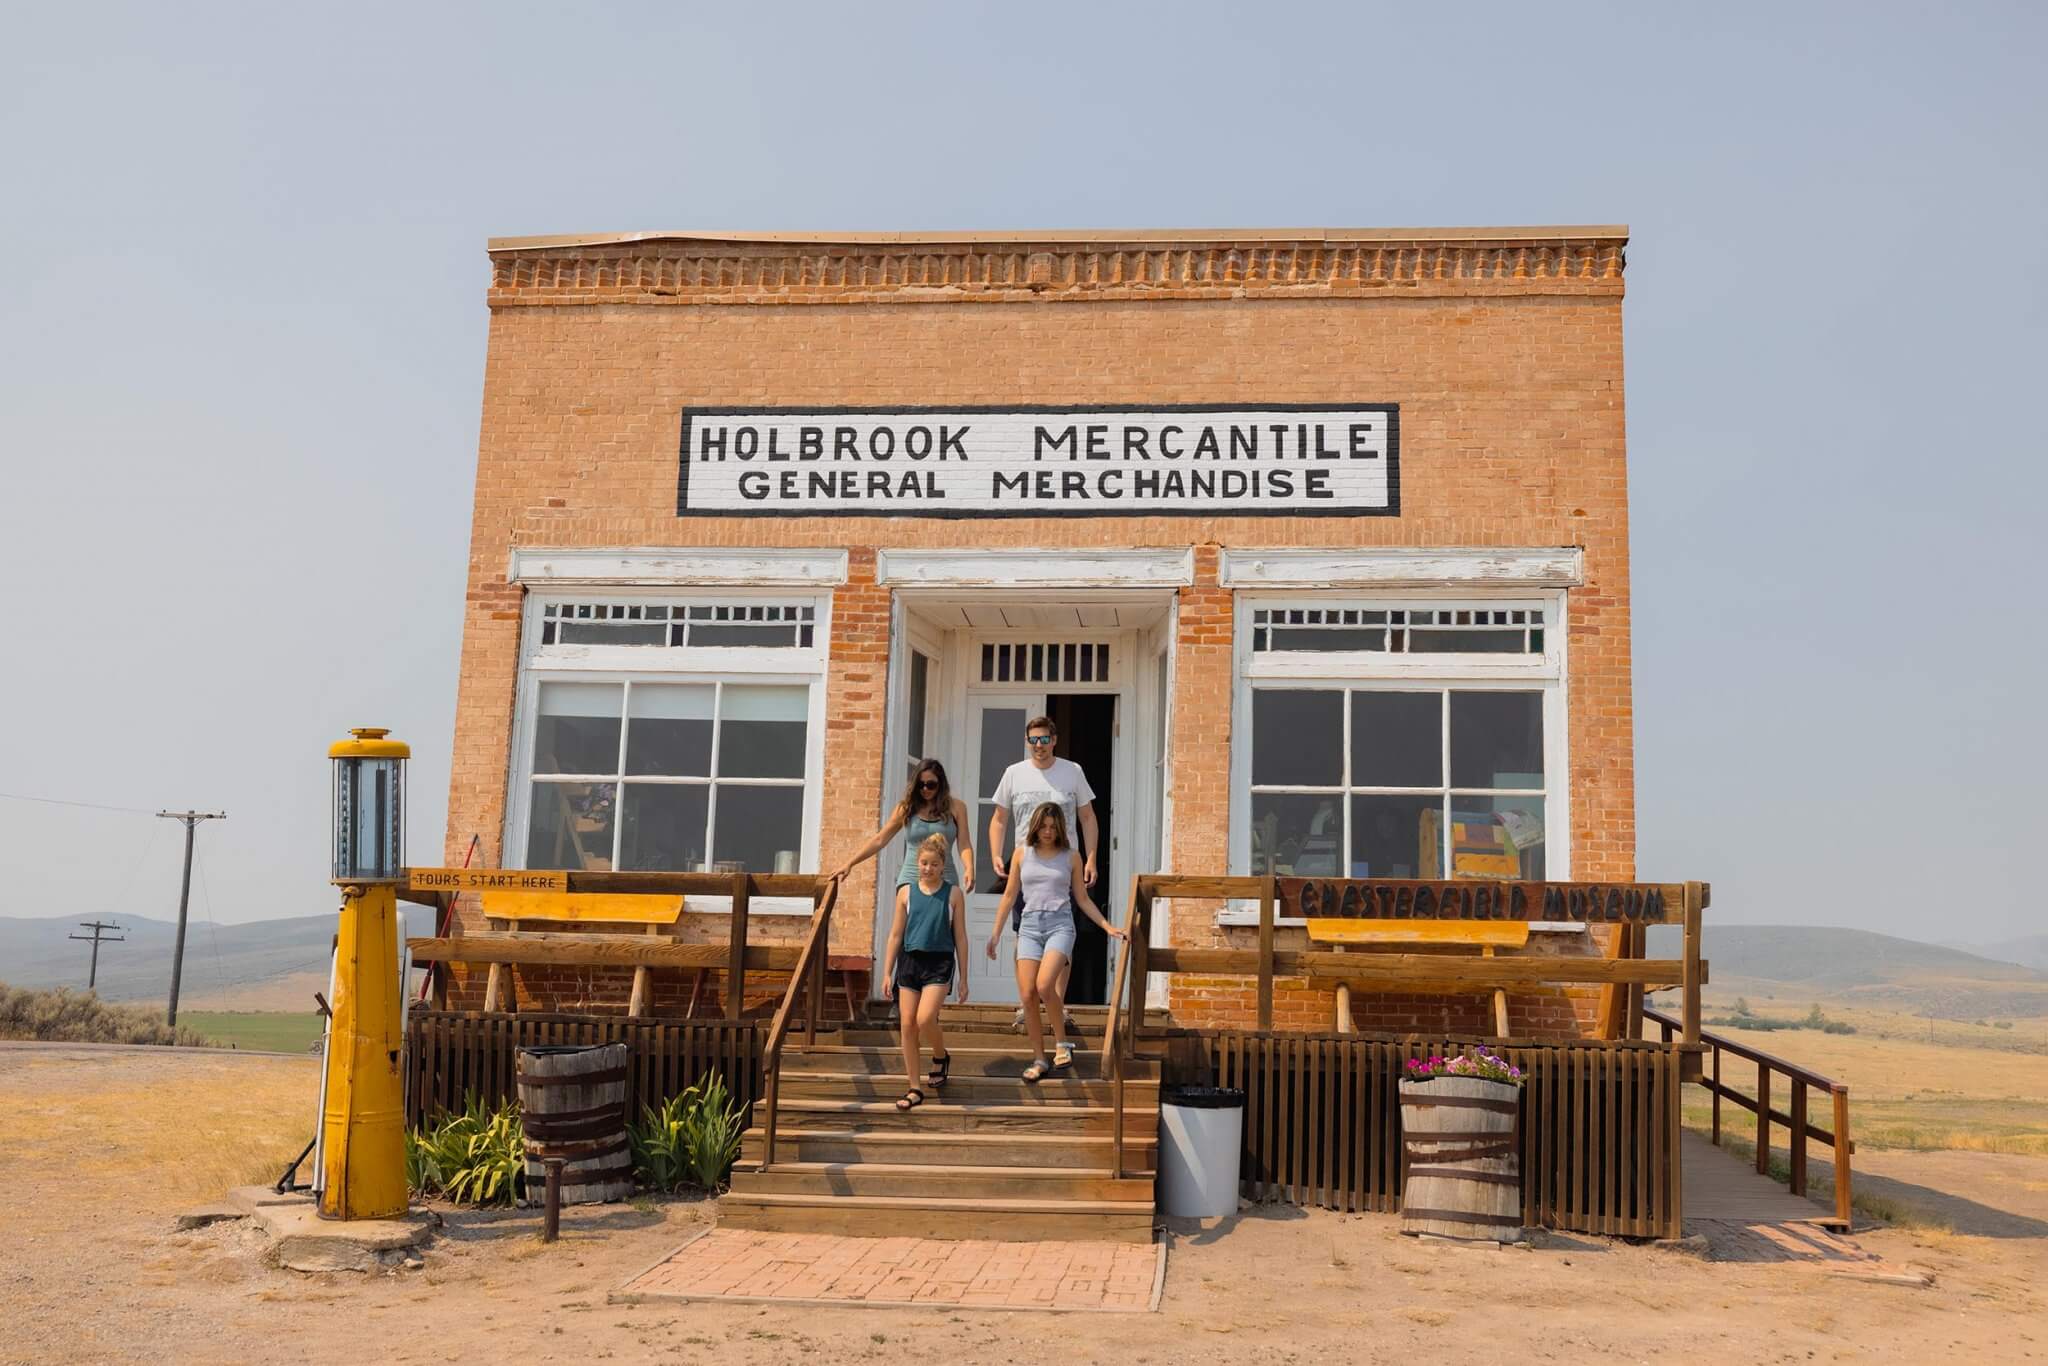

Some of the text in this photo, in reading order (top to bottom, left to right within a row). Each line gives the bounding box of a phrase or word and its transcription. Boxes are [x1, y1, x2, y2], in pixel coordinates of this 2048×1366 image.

[701, 424, 1379, 461] HOLBROOK MERCANTILE
[738, 470, 1334, 499] GENERAL MERCHANDISE
[416, 873, 556, 889] TOURS START HERE
[1300, 882, 1665, 921] CHESTERFIELD MUSEUM
